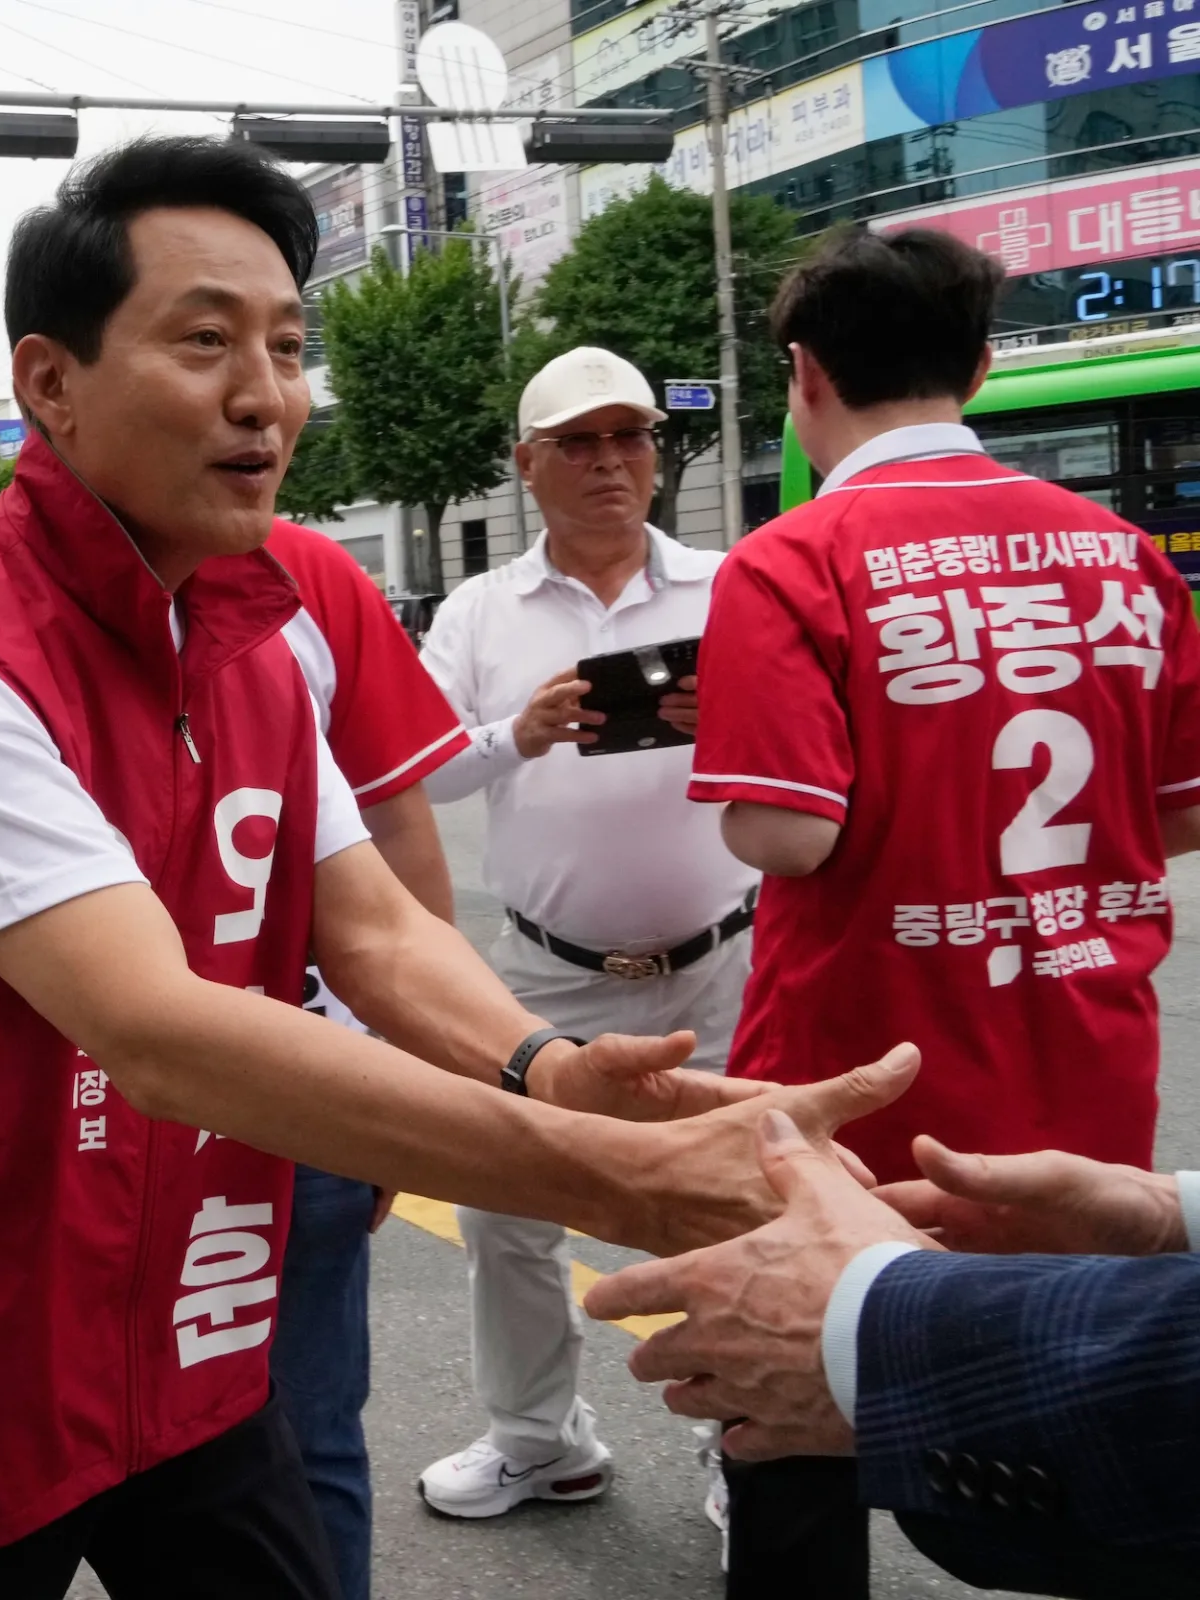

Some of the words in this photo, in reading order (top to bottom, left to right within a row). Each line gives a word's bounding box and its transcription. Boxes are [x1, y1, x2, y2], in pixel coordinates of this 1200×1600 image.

[1068, 186, 1200, 254] 대들
[1076, 258, 1200, 321] 2:17
[864, 535, 1002, 590] 멈춘중랑!
[1006, 531, 1139, 572] 다시뛰게!
[866, 580, 1165, 705] 황종석
[992, 709, 1094, 876] 2
[893, 885, 1088, 947] 중랑구청장
[1095, 876, 1169, 923] 후보
